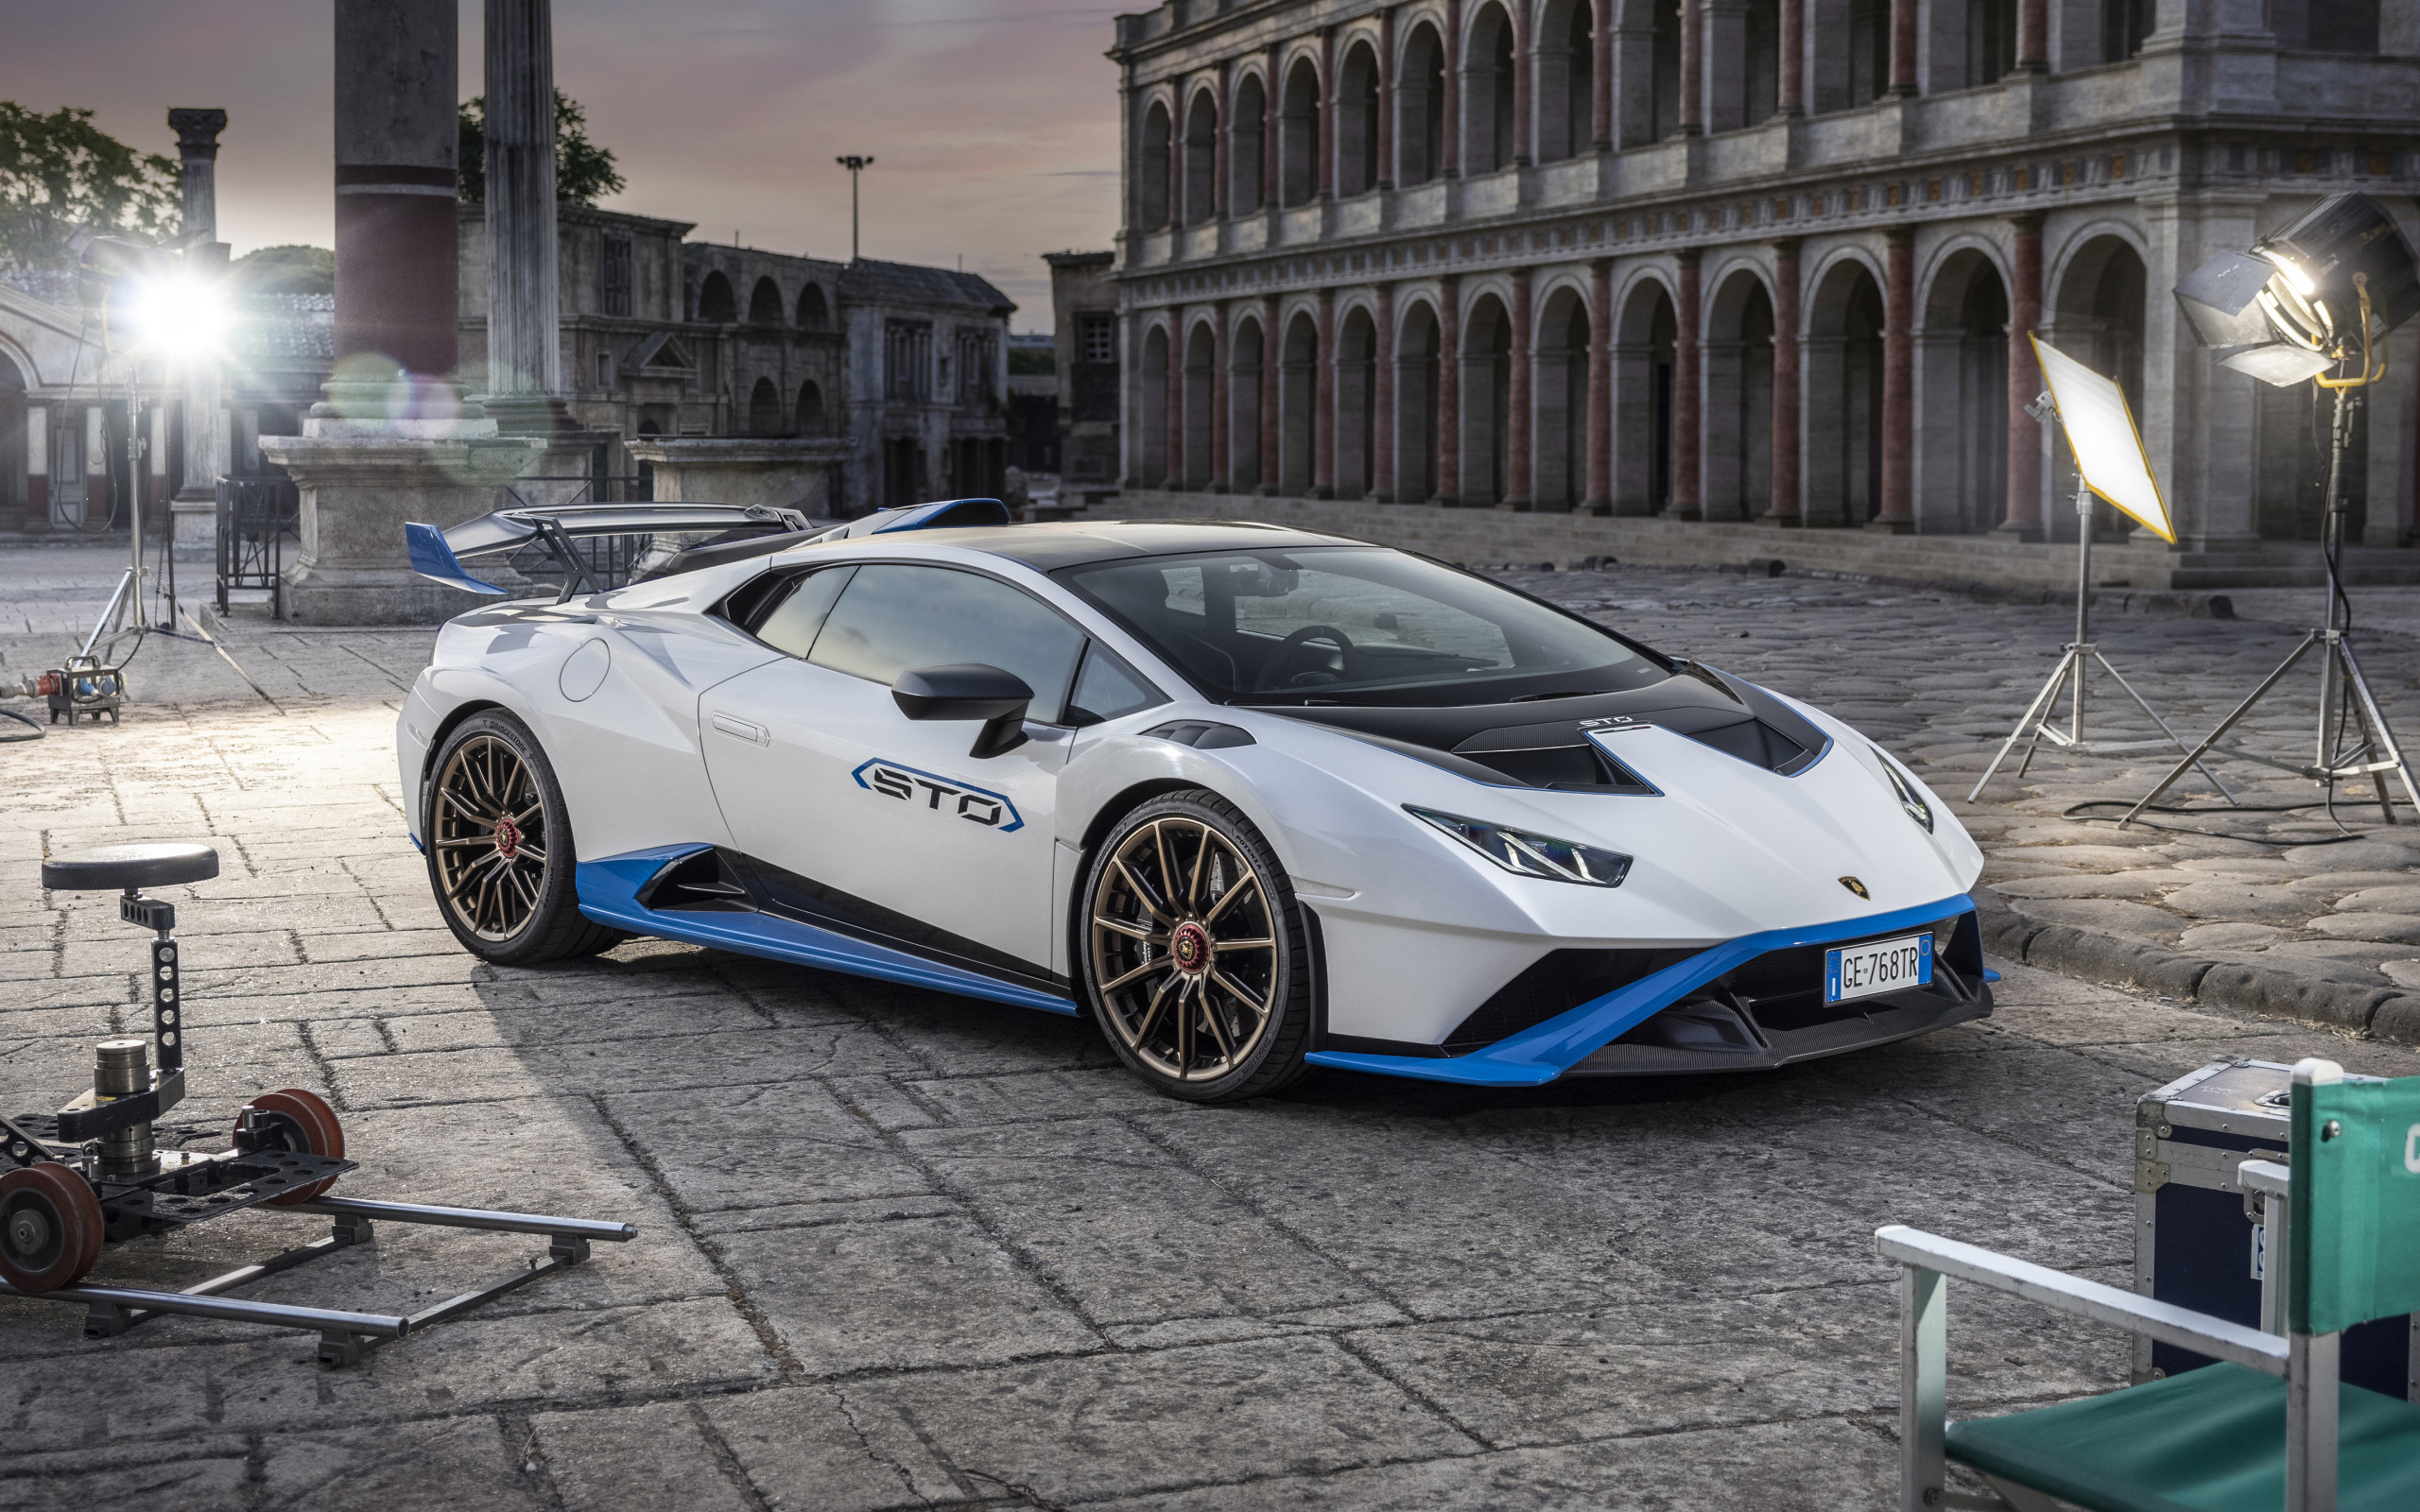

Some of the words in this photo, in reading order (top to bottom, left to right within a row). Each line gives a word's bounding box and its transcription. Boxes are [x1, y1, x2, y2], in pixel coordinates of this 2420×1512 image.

[489, 721, 527, 754] BRIDGESTONE
[873, 768, 1002, 827] STO
[1236, 834, 1262, 870] POTENZA
